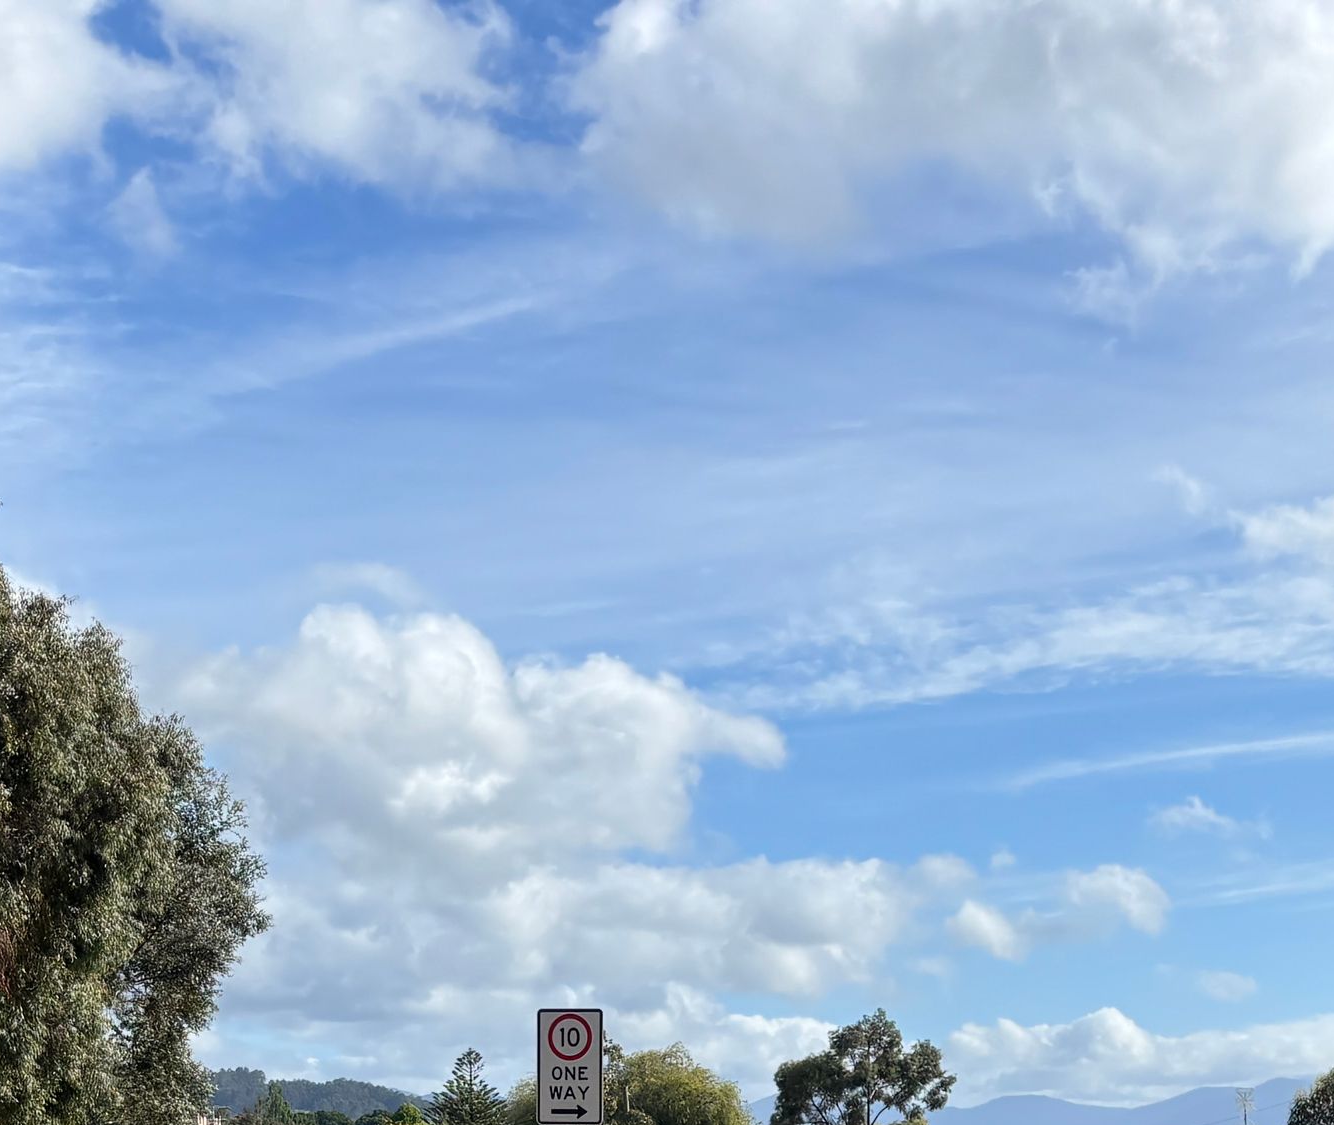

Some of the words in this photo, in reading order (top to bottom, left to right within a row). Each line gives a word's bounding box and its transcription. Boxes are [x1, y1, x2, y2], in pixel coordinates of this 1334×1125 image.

[560, 1028, 580, 1047] 10
[552, 1067, 588, 1081] ONE
[550, 1086, 589, 1100] WAY
